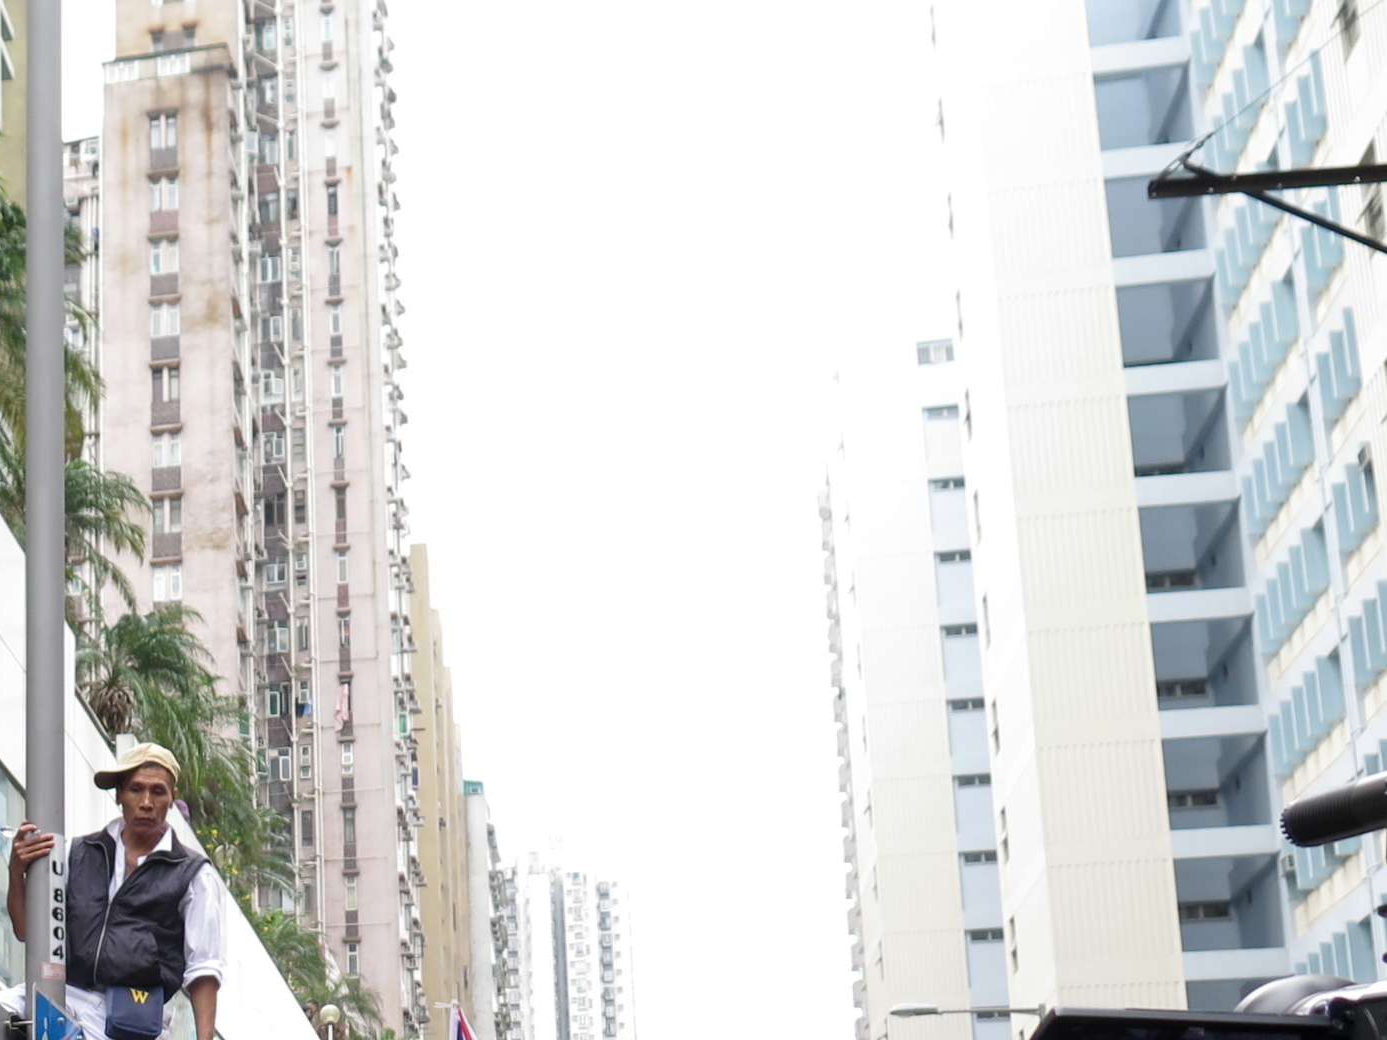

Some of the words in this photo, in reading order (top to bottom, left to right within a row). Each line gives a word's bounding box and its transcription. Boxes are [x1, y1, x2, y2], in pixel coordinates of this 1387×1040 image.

[52, 861, 64, 876] U
[52, 888, 65, 960] 8604
[130, 987, 150, 1004] W
